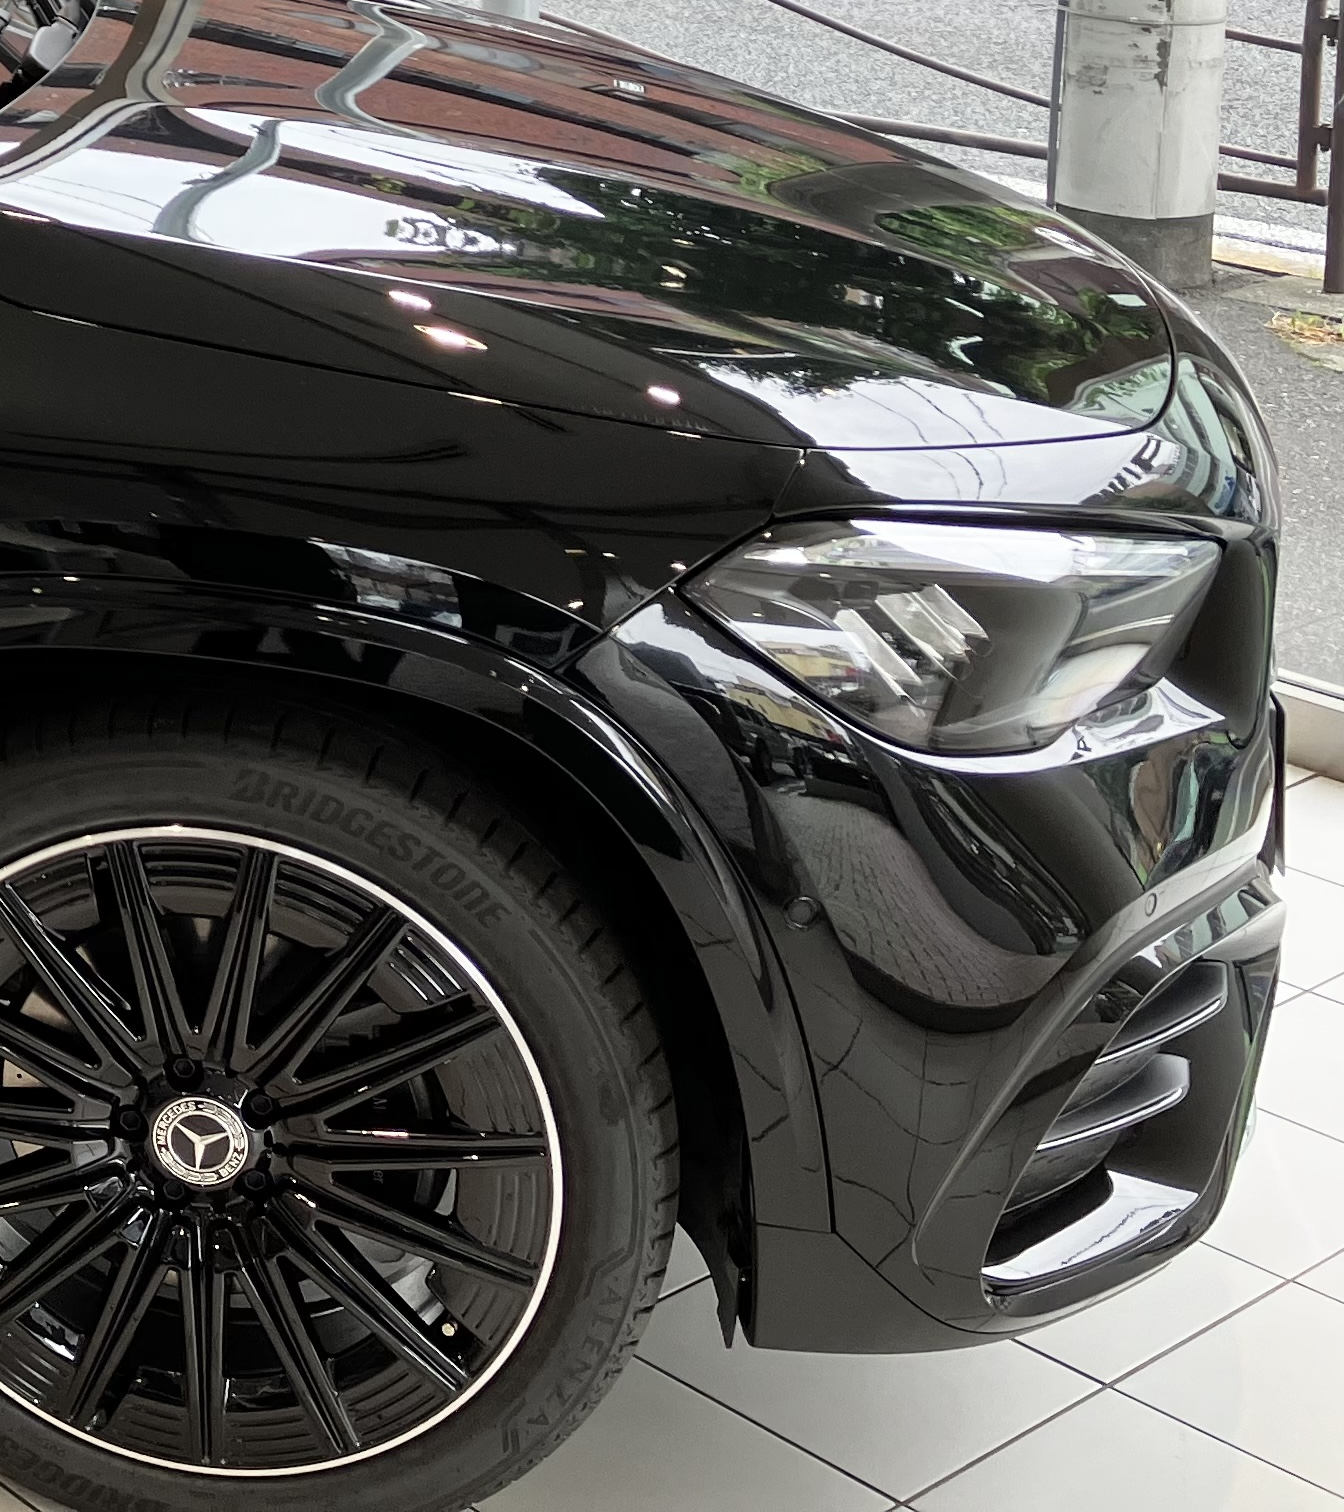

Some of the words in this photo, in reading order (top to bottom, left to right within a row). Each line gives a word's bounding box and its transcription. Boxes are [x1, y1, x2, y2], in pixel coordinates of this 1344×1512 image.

[228, 767, 511, 930] BRIDGESTONE
[156, 1101, 197, 1145] MERCEDES
[218, 1151, 244, 1178] BENZ
[524, 1287, 623, 1427] ALENZA
